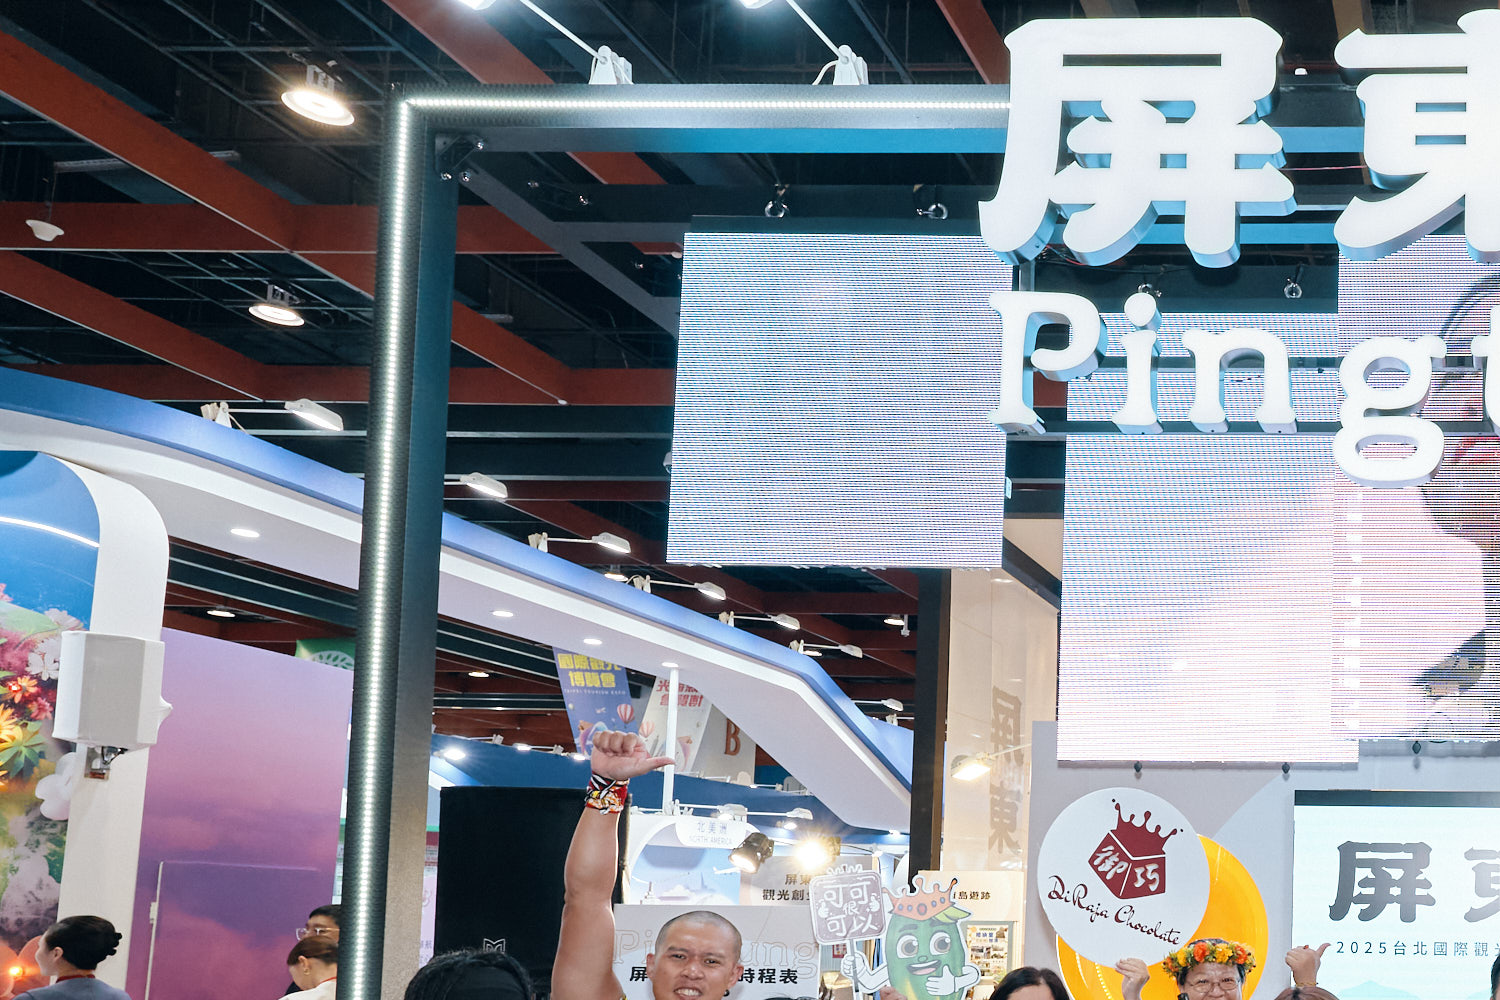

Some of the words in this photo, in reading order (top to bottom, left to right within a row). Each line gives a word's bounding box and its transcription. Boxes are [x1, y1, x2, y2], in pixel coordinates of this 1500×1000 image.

[762, 888, 811, 901] 觀光創
[822, 881, 871, 909] 可可
[952, 890, 991, 900] 島遊跡
[842, 901, 858, 916] 很
[826, 914, 878, 937] 可以
[1113, 905, 1182, 946] Chocolate
